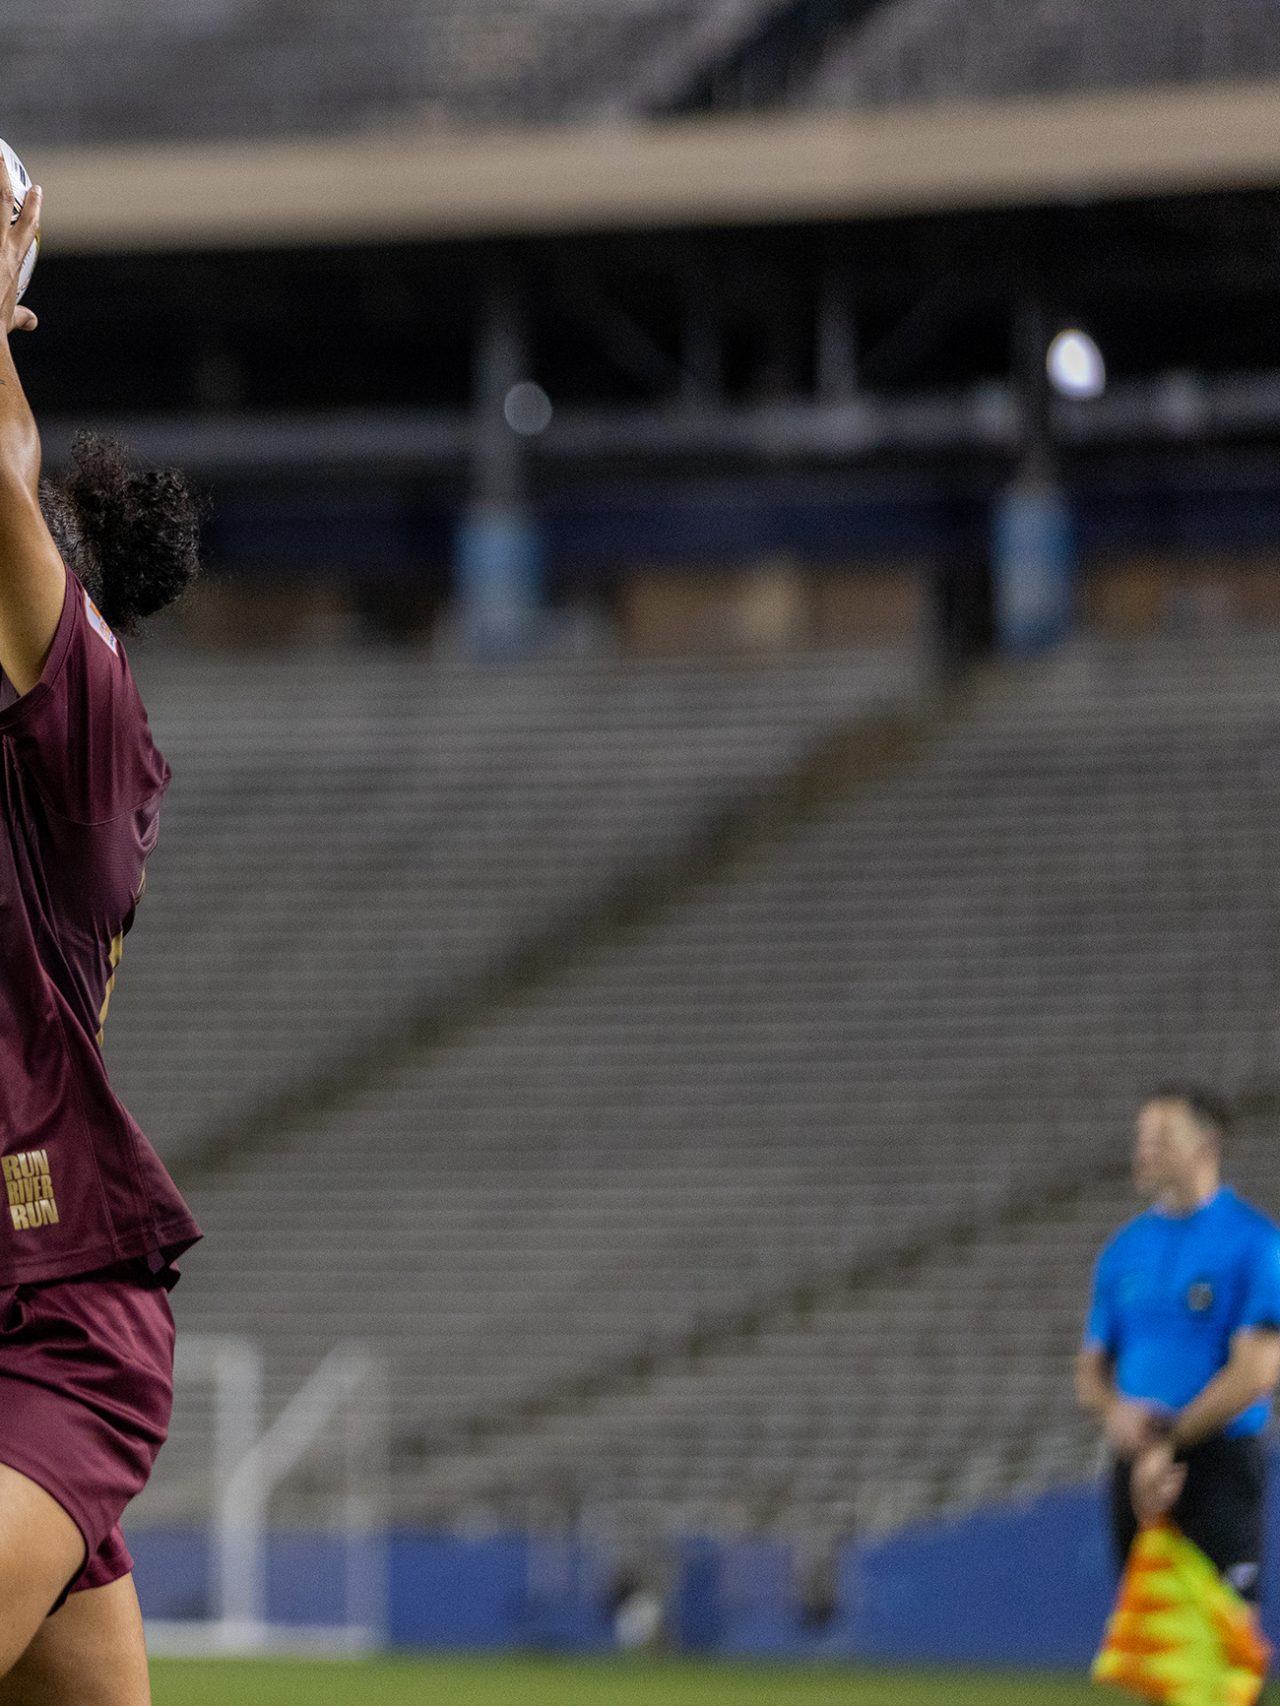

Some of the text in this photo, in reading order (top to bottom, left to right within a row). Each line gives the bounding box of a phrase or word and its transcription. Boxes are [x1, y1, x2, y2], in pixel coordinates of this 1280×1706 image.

[1, 1149, 50, 1181] RUN
[6, 1174, 54, 1206] RIVER
[10, 1198, 60, 1231] RUN
